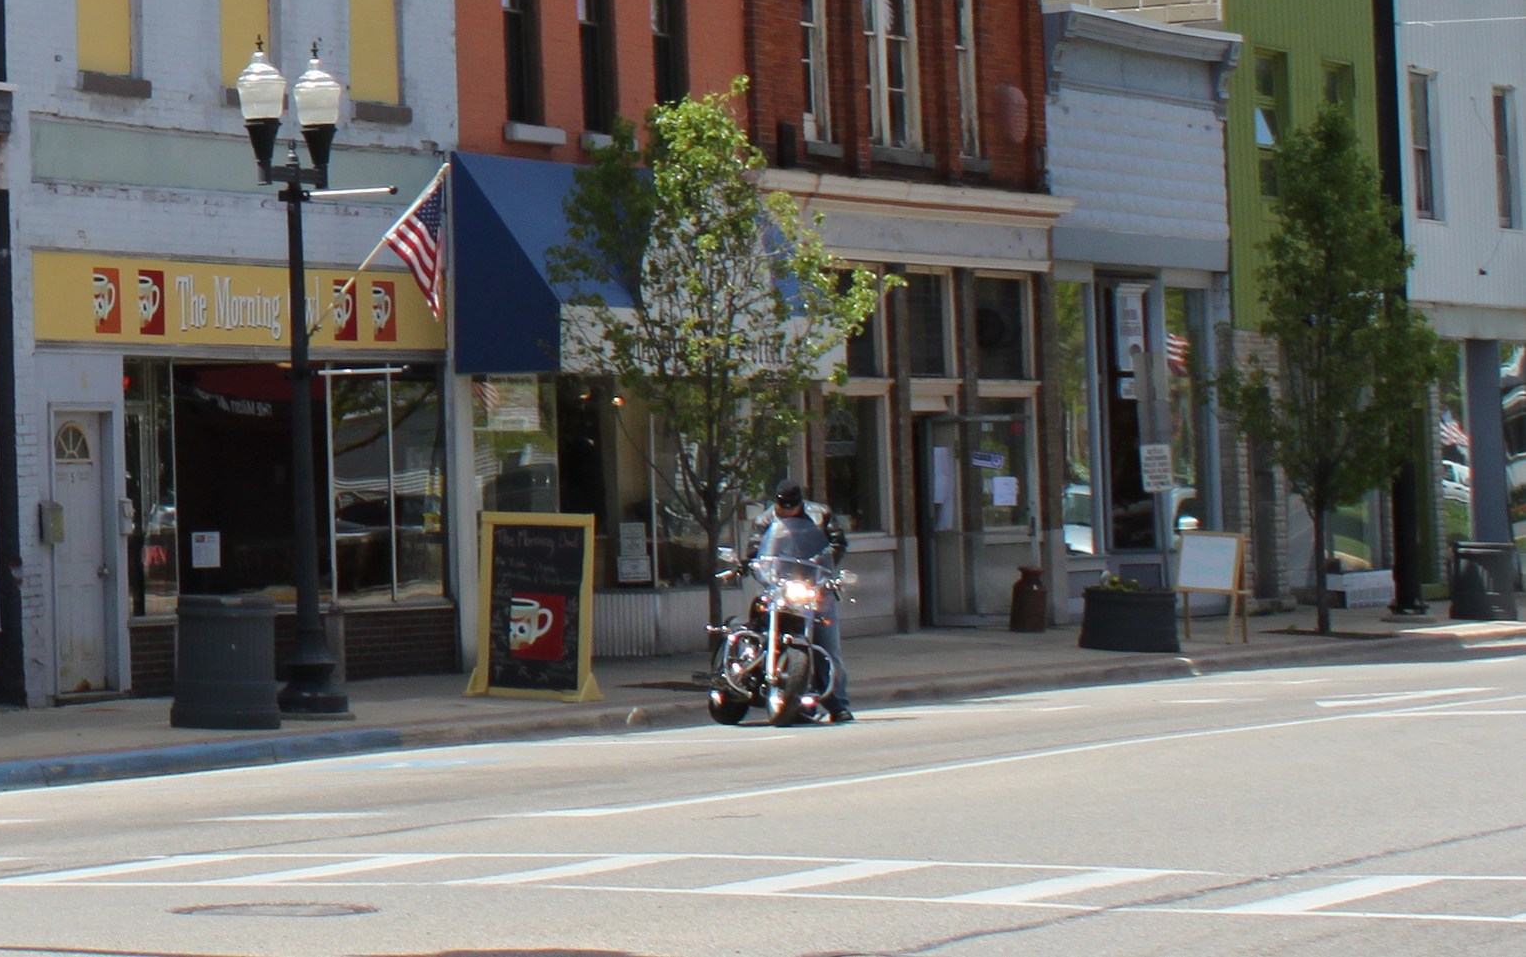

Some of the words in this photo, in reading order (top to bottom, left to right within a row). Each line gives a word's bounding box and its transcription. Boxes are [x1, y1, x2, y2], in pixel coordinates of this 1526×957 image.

[175, 274, 207, 332] The
[212, 275, 283, 341] Morning
[287, 276, 322, 330] wl
